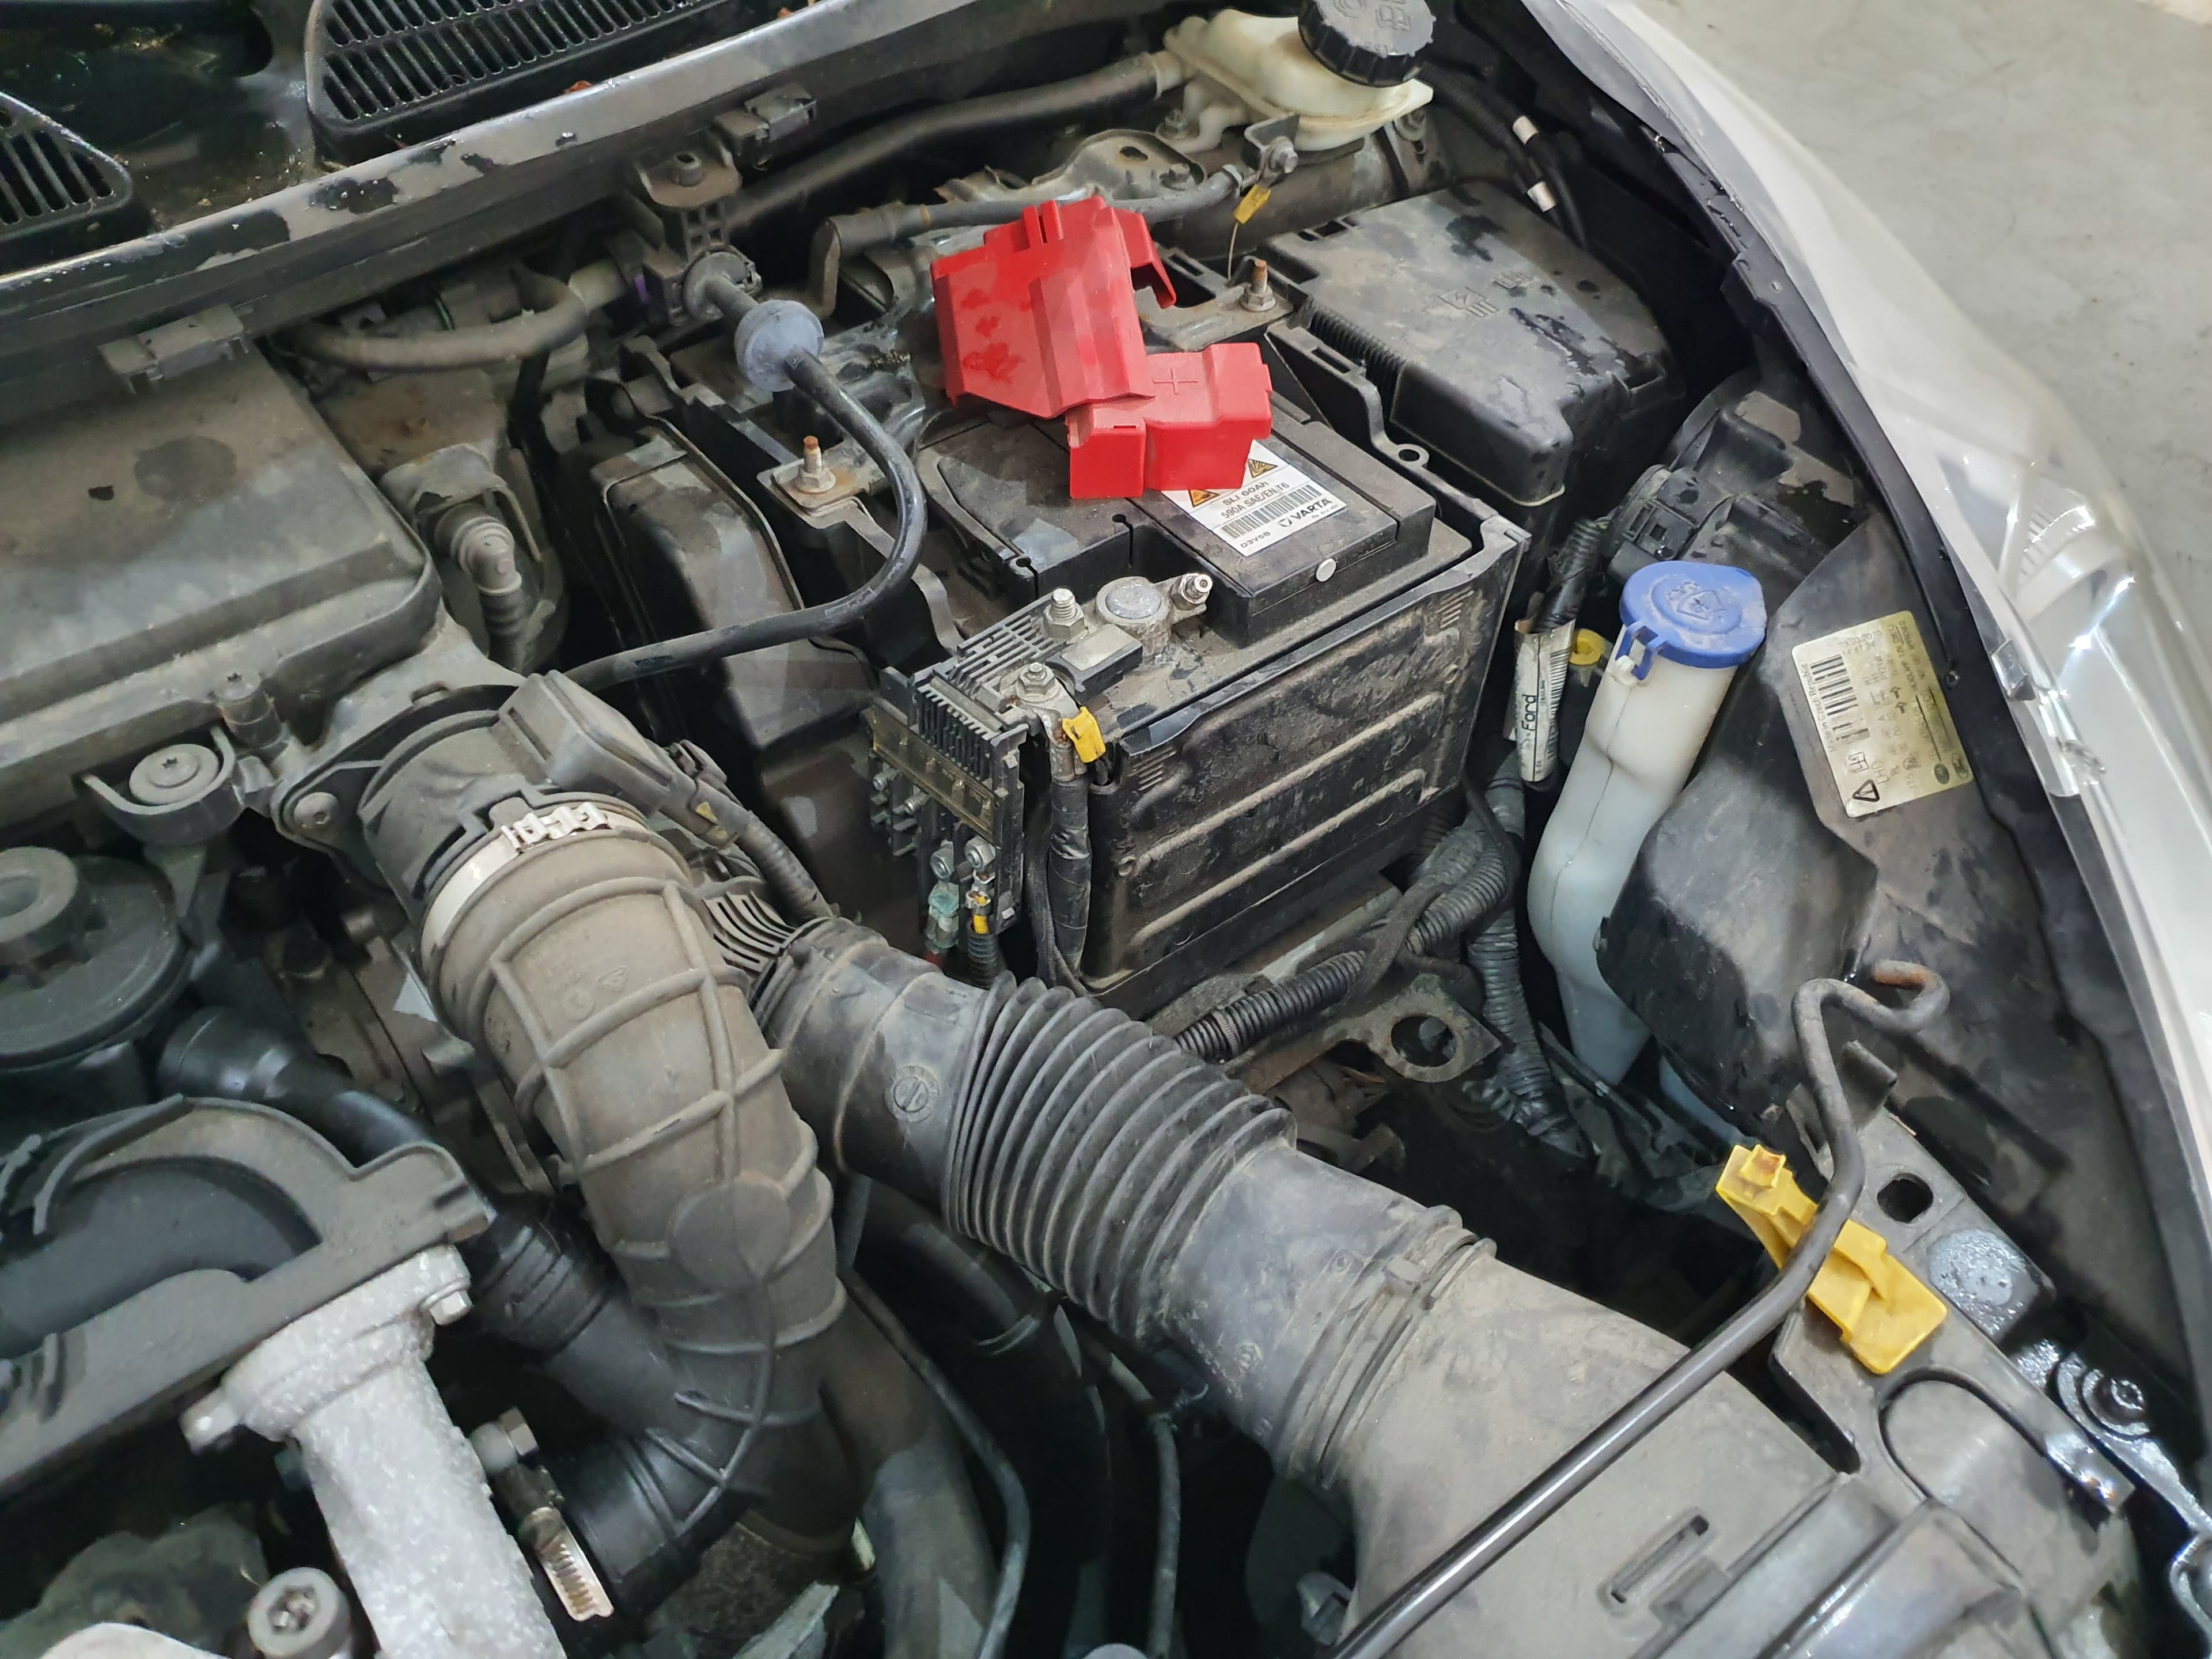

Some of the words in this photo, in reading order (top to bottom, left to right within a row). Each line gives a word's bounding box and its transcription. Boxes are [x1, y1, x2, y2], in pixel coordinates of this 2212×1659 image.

[1221, 503, 1246, 519] 590A
[1244, 487, 1278, 507] SAE/EN
[1222, 494, 1241, 506] SLI
[1241, 481, 1269, 497] 60Ah
[1290, 497, 1332, 520] VARTA
[1801, 664, 1817, 696] Republic
[1521, 694, 1537, 732] Ford
